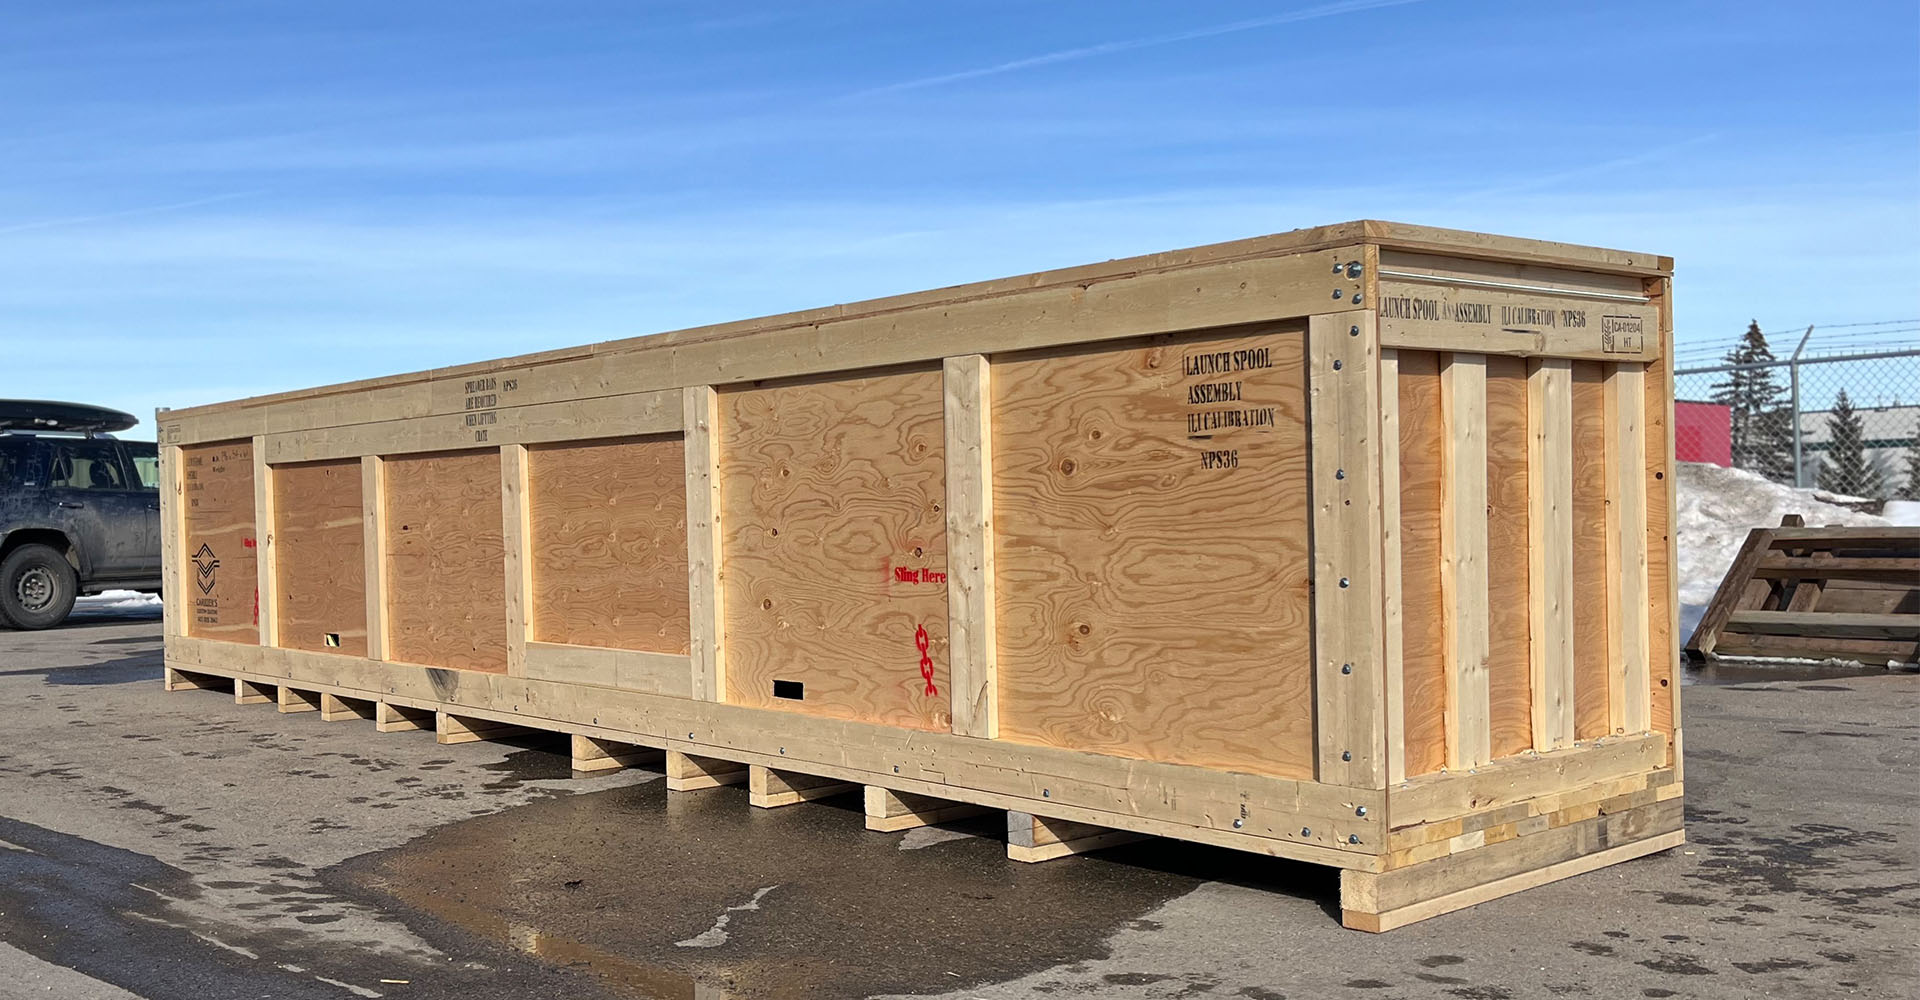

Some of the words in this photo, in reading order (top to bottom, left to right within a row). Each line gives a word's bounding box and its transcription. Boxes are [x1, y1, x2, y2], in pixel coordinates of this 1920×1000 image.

[1378, 296, 1411, 320] LAUNCH
[1412, 298, 1440, 321] SPOOL
[1454, 302, 1492, 324] ASSEMBLY
[1512, 307, 1556, 328] CALIBRATION
[1562, 309, 1586, 328] NPS36
[1623, 337, 1632, 348] HT
[1186, 352, 1230, 376] LAUNCH
[1233, 348, 1273, 371] SPOOL
[1187, 381, 1243, 404] ASSEMBLY
[1204, 408, 1275, 431] CALIBRATION
[1201, 449, 1239, 469] NPS36
[895, 566, 919, 585] Sling
[922, 568, 946, 583] Here
